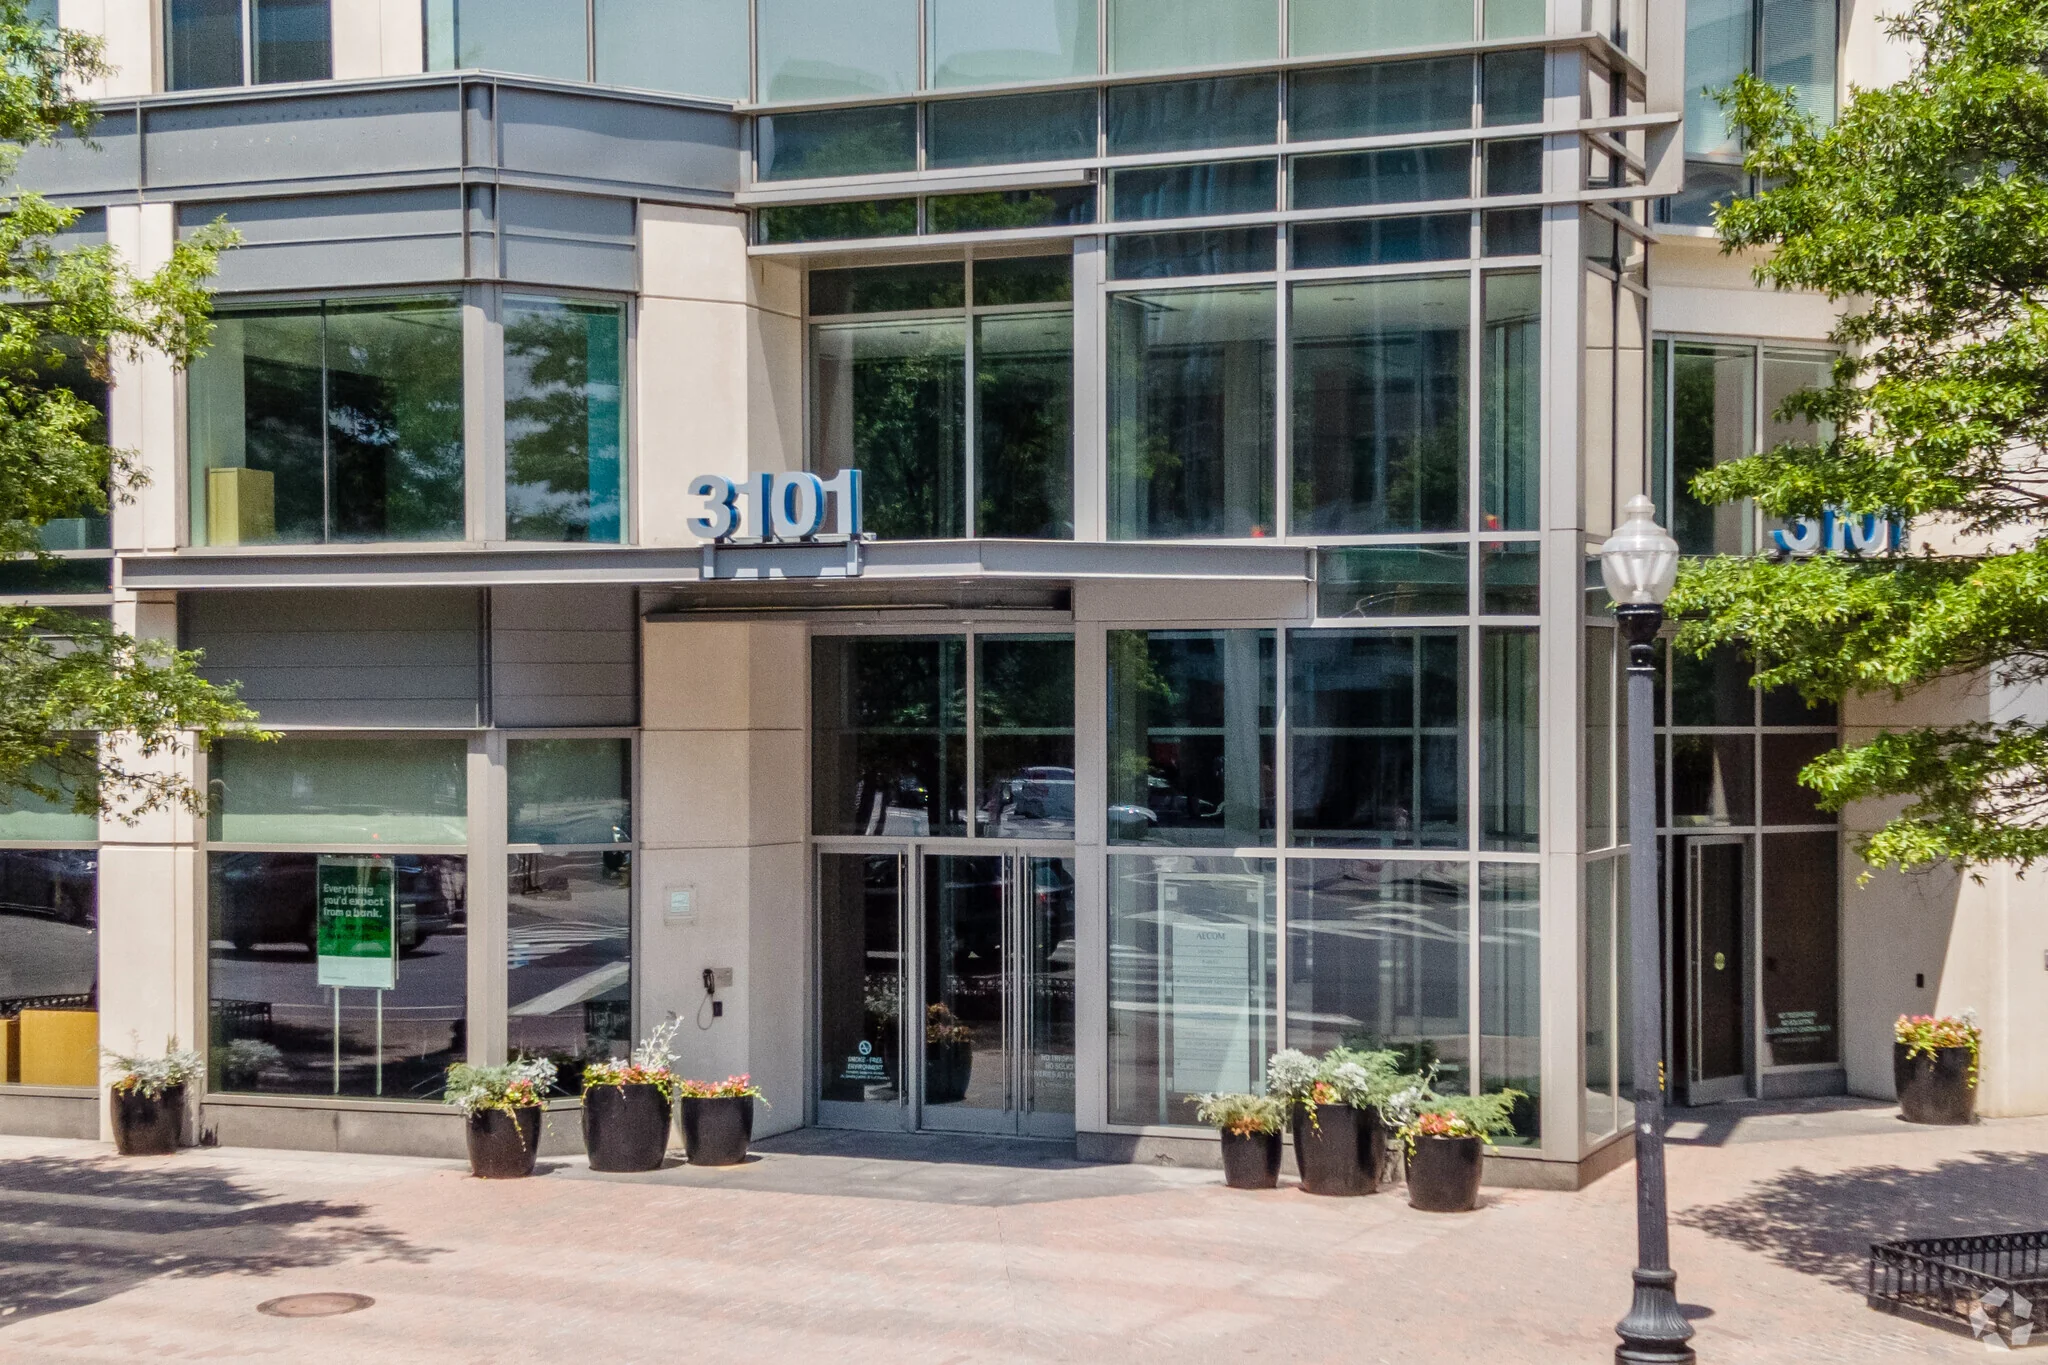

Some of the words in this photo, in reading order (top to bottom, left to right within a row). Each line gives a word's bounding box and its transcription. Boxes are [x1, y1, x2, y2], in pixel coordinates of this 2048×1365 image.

[687, 469, 862, 539] 3101
[323, 883, 374, 897] Everything
[324, 896, 348, 906] you'd
[349, 897, 384, 908] expect
[323, 906, 344, 917] from
[345, 909, 352, 917] a
[353, 907, 382, 918] bank.
[1197, 931, 1226, 941] AECOM
